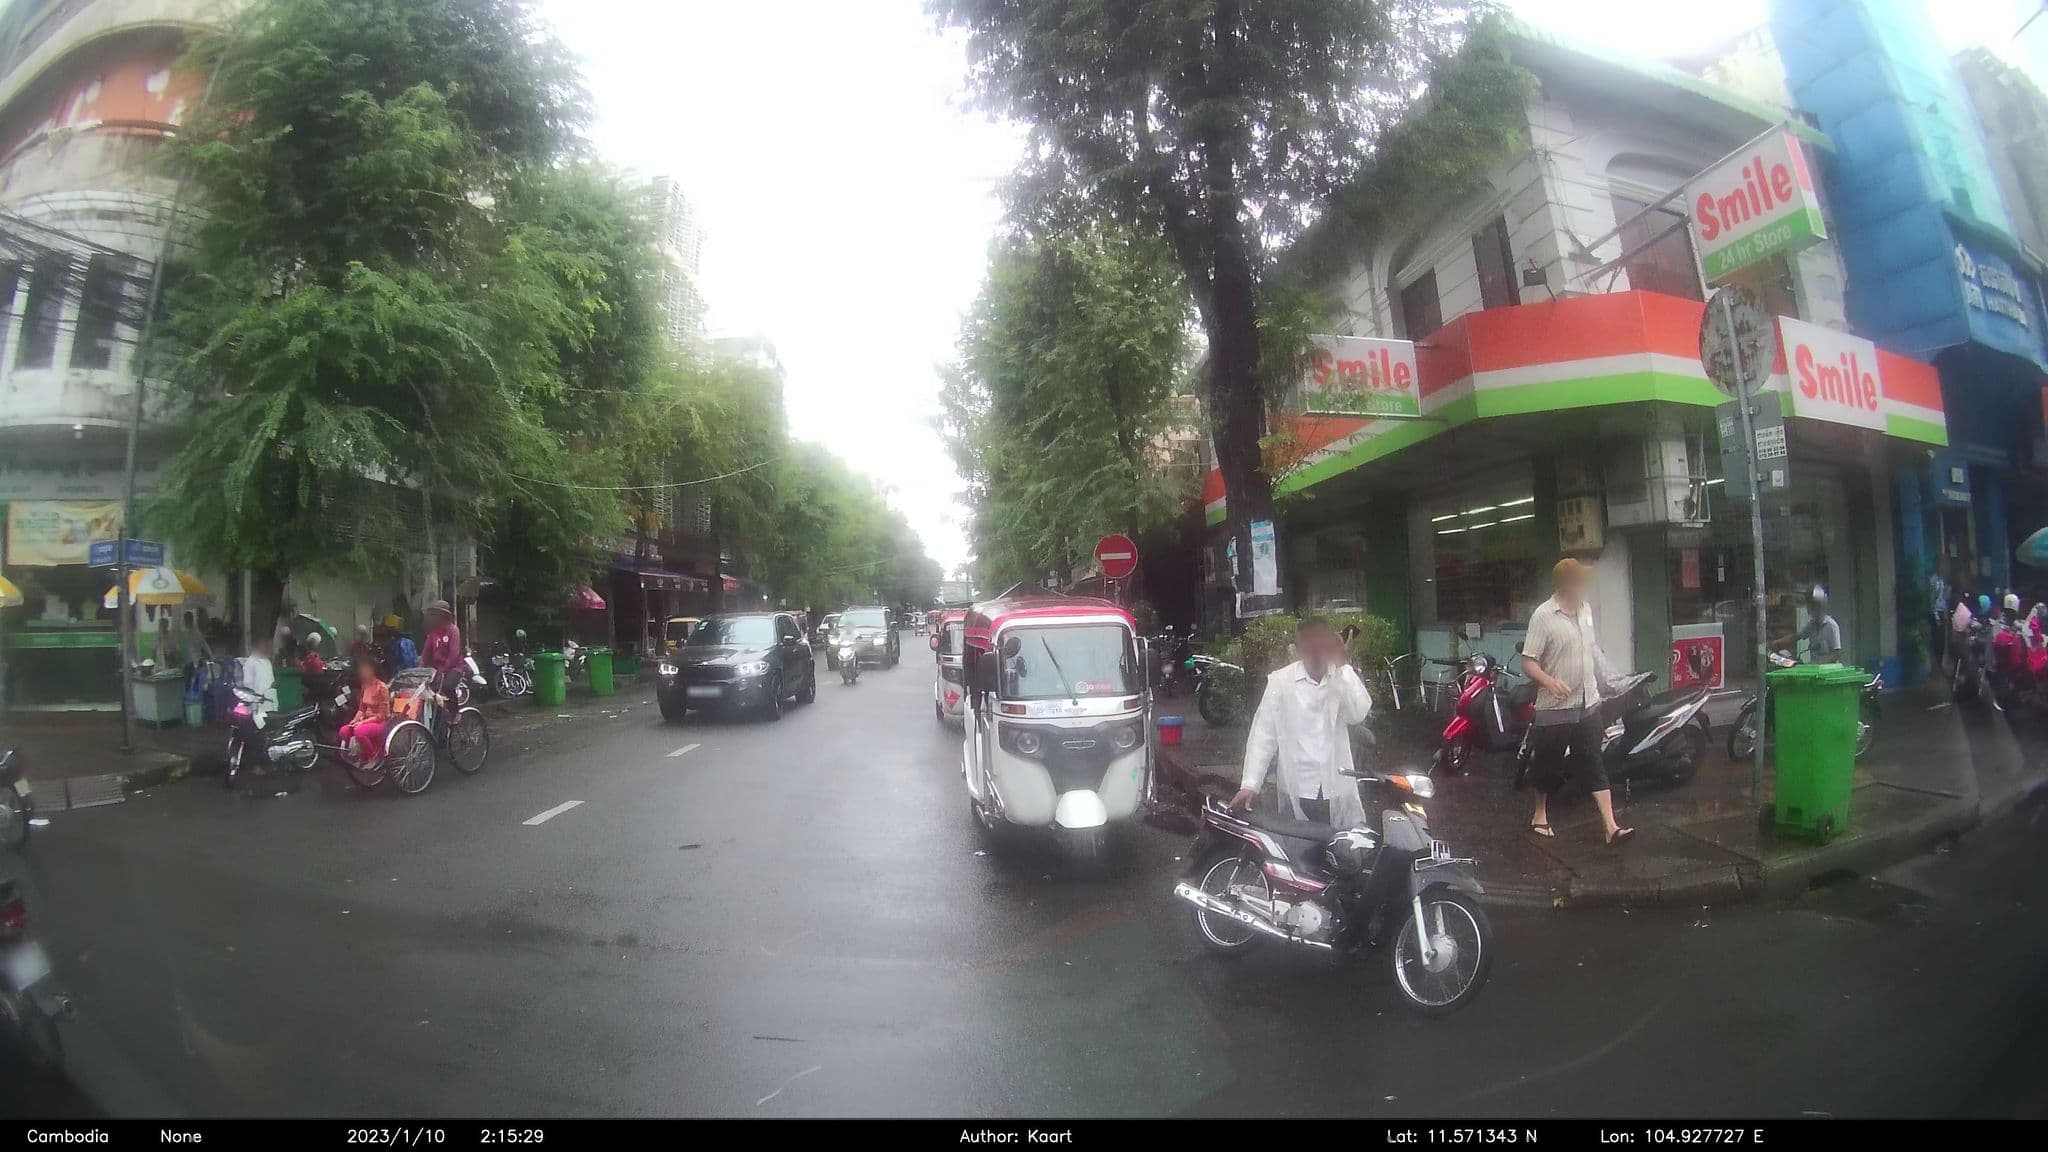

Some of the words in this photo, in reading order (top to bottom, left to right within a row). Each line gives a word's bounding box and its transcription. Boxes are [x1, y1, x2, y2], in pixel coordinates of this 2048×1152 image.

[1696, 155, 1793, 241] Smile
[1717, 251, 1735, 270] 24
[1737, 245, 1751, 262] hr
[1753, 224, 1792, 251] Store
[1311, 347, 1411, 390] Smile
[1795, 343, 1878, 412] Smile
